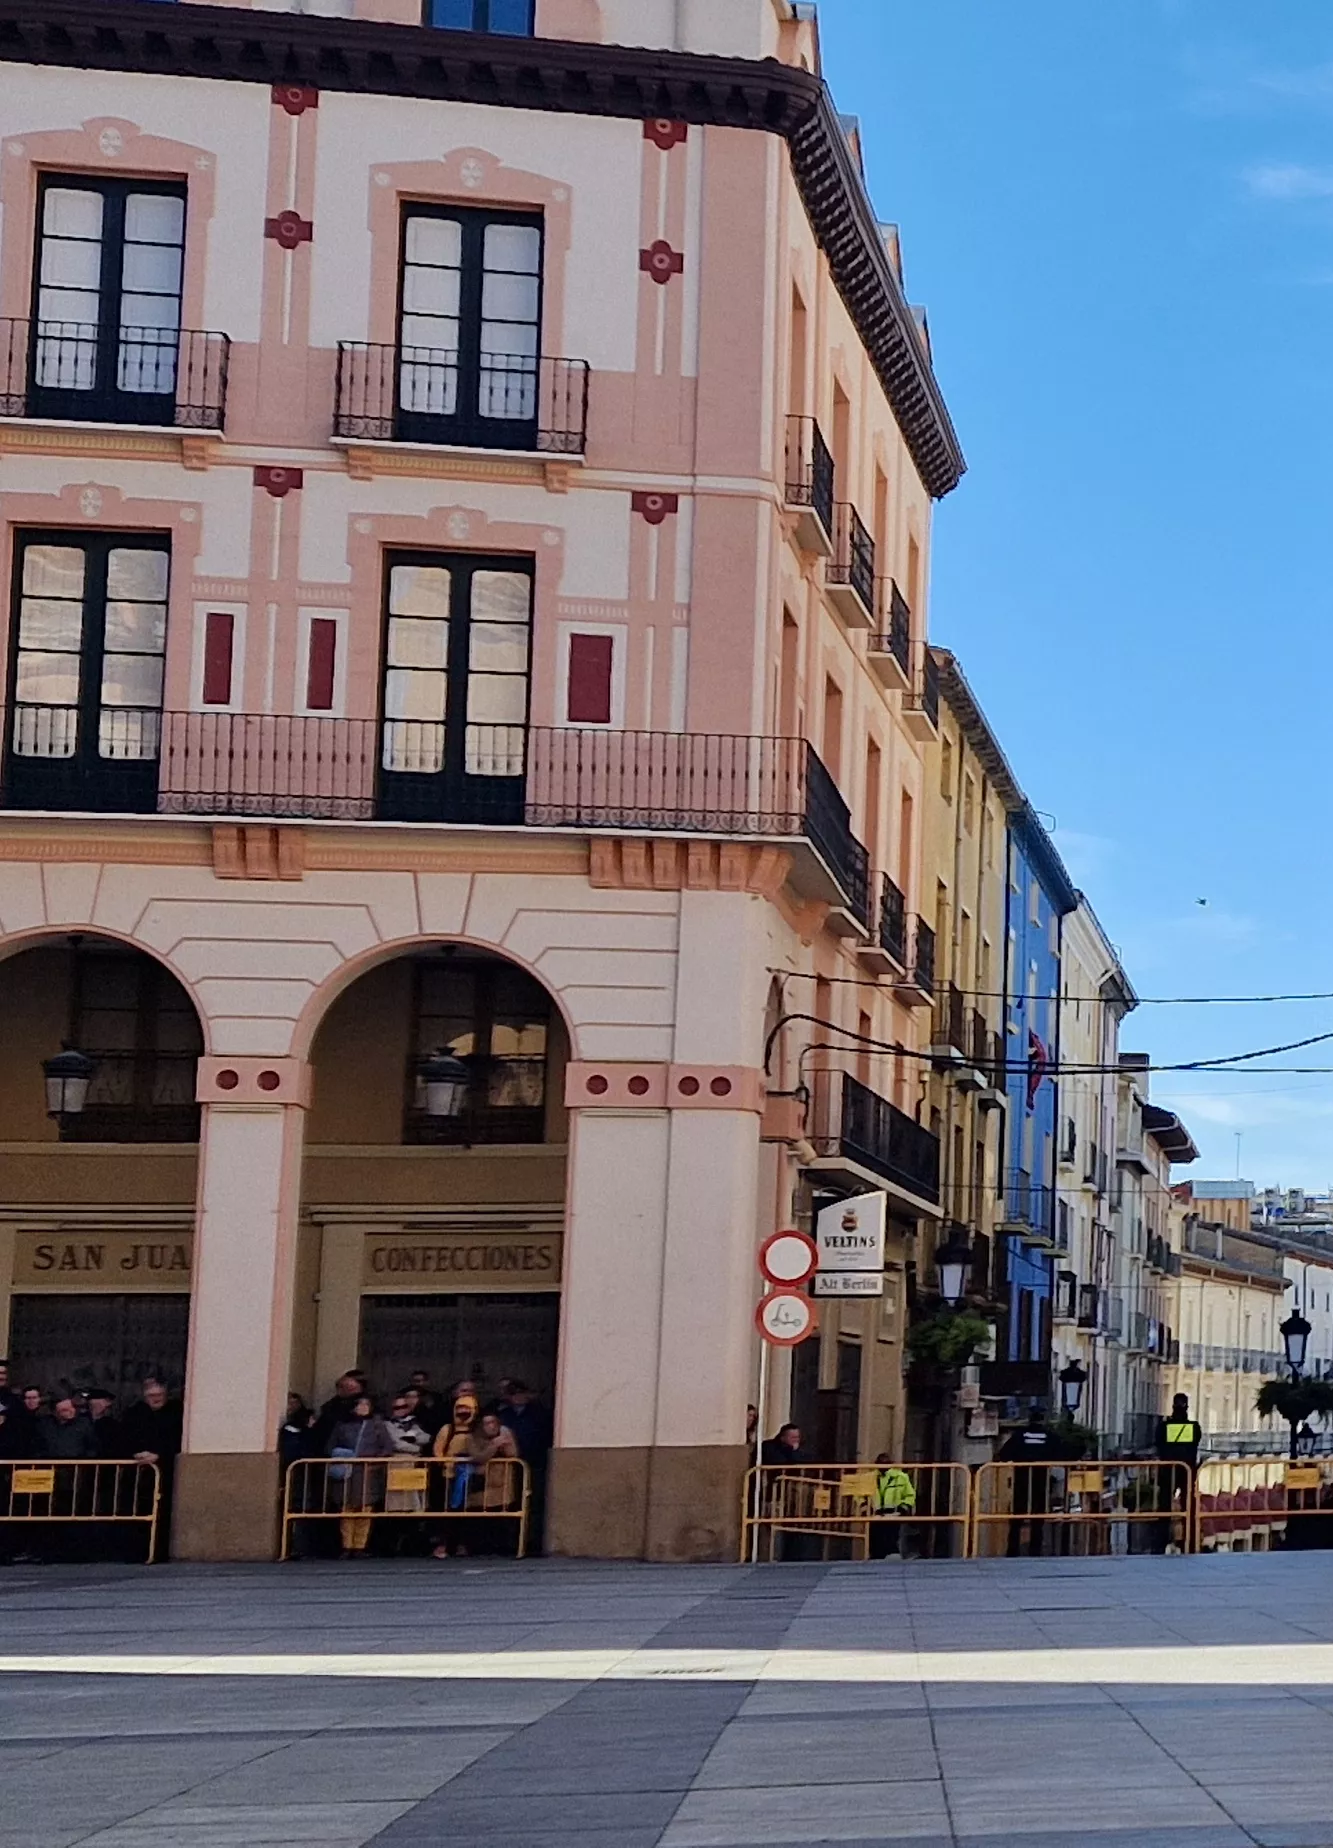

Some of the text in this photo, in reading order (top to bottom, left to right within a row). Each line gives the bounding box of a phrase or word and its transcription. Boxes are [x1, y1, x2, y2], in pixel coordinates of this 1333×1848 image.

[824, 1236, 876, 1248] VELTINS
[33, 1245, 191, 1270] SAN JUA
[372, 1245, 553, 1272] CONFECCIONES
